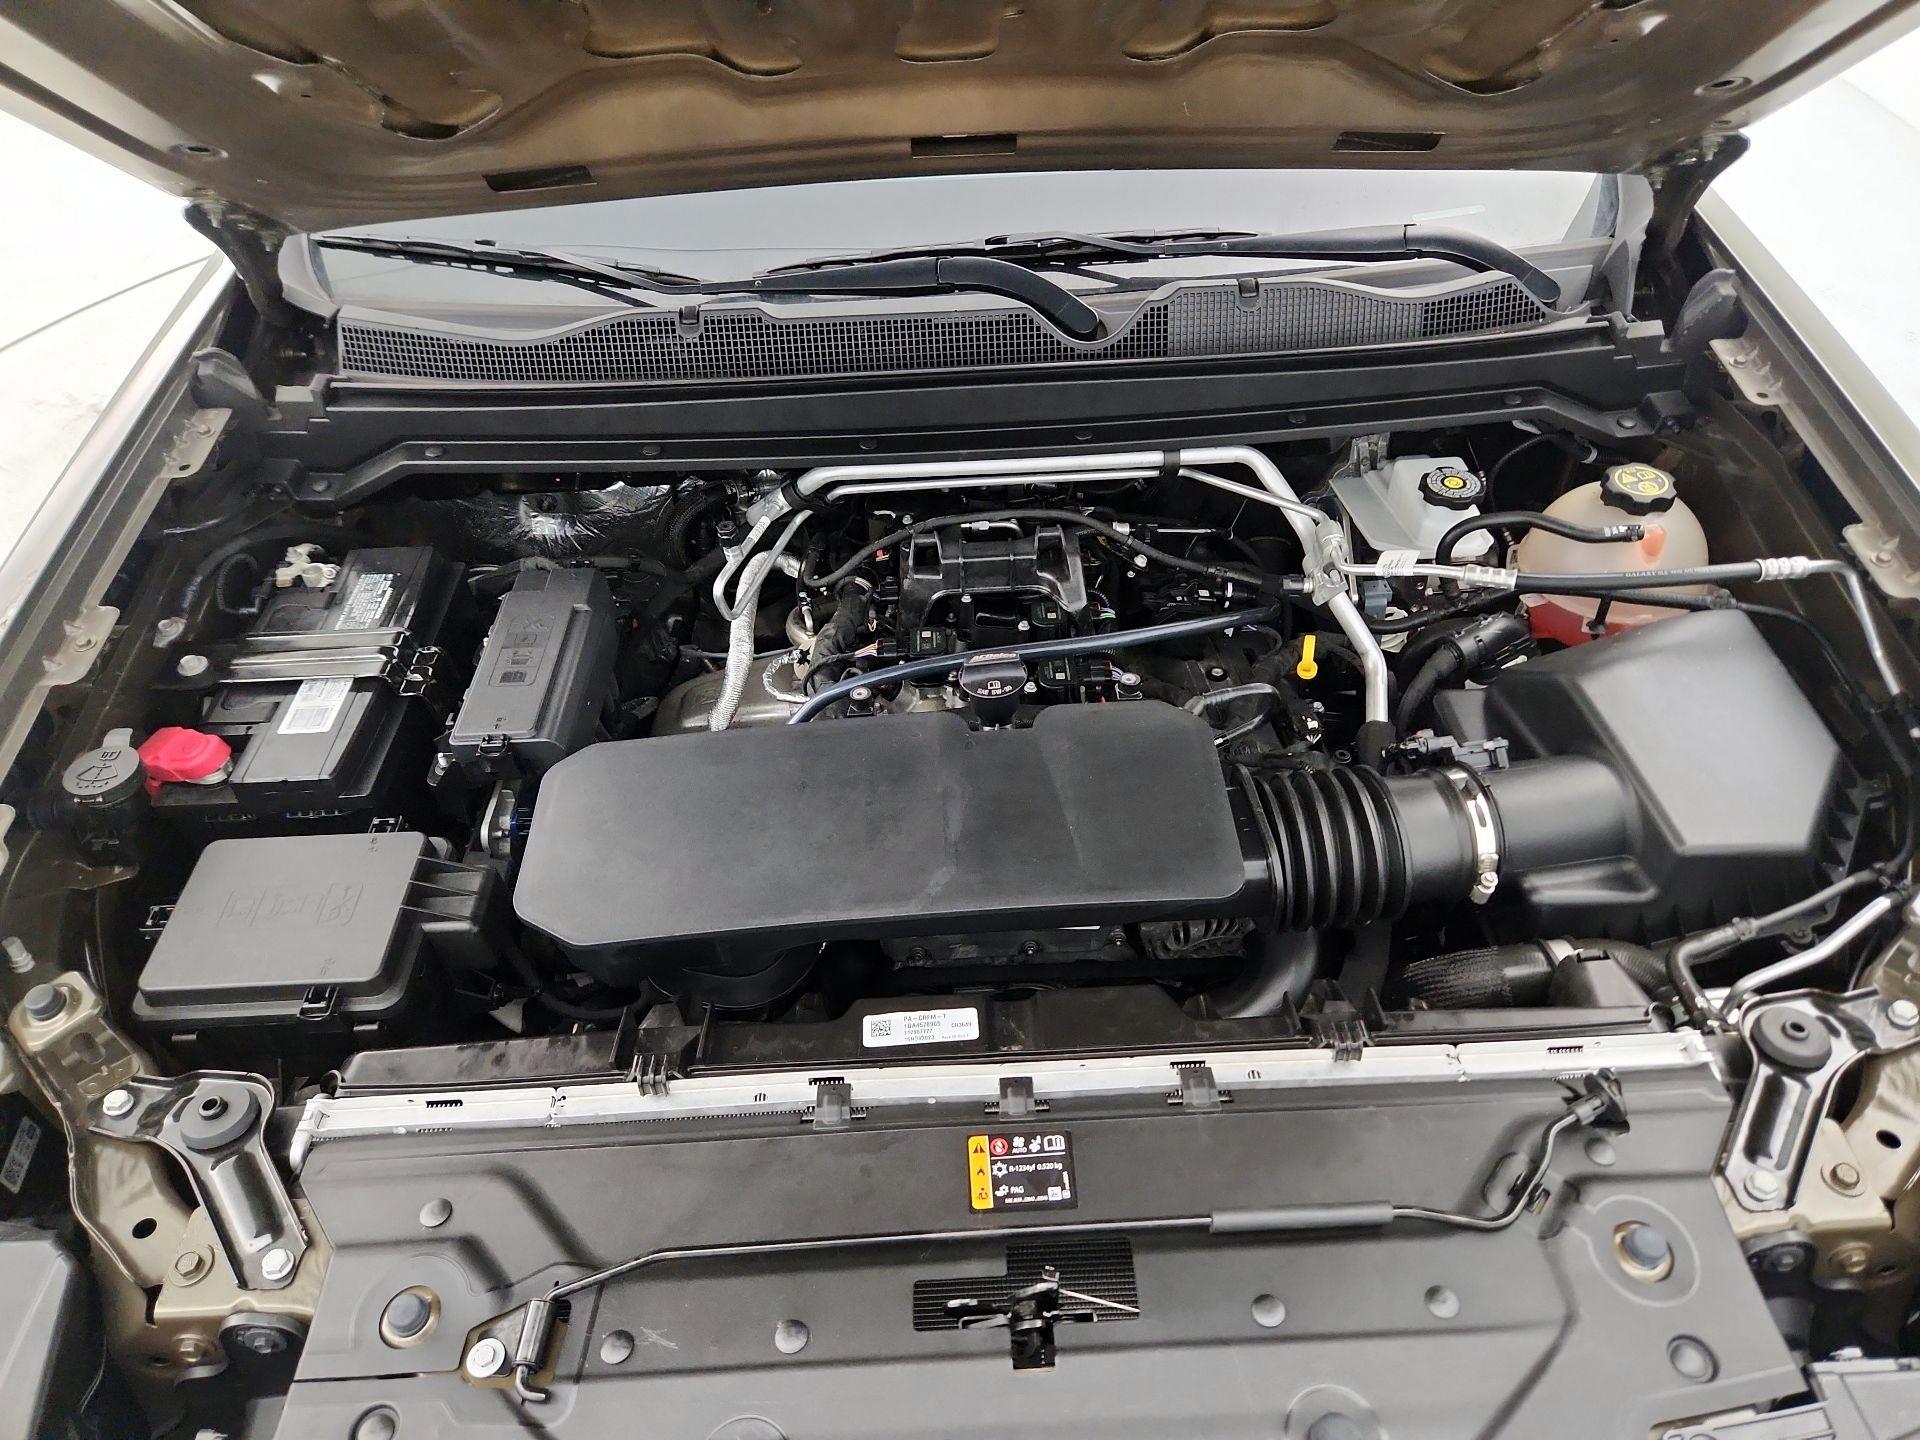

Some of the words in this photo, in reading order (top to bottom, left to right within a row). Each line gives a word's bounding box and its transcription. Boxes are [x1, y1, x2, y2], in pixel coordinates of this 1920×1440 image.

[969, 653, 1017, 663] ACDelco
[1008, 1163, 1036, 1172] R-1234yf
[1054, 1161, 1063, 1171] kg
[1010, 1185, 1024, 1193] PAG
